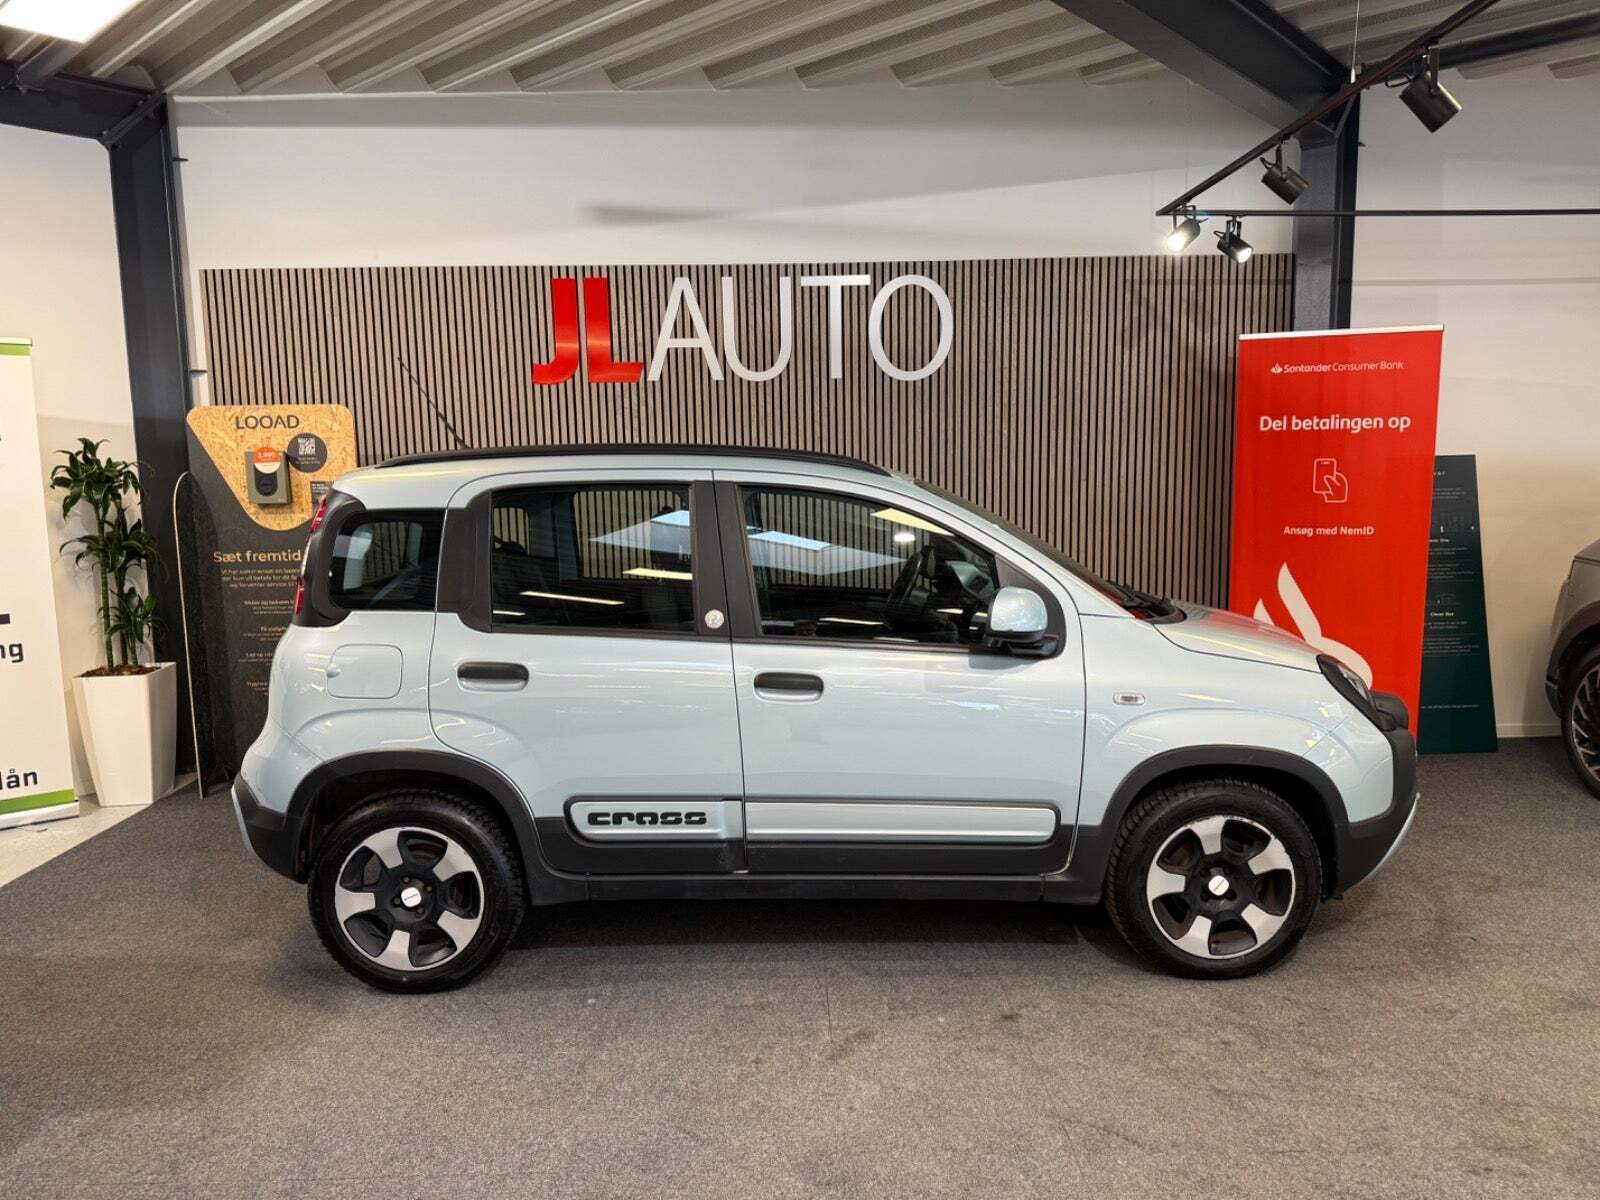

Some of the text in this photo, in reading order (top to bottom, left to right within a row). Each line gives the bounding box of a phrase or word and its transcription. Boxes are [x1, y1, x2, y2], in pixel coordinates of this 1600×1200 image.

[530, 274, 954, 384] JL AUTO
[1283, 360, 1404, 373] Santander Consumer Bank
[235, 414, 300, 430] LOOAD
[1259, 414, 1411, 434] Del betalingen op
[1283, 525, 1375, 537] Ansøg med NemID
[213, 549, 302, 563] Sæt fremtid
